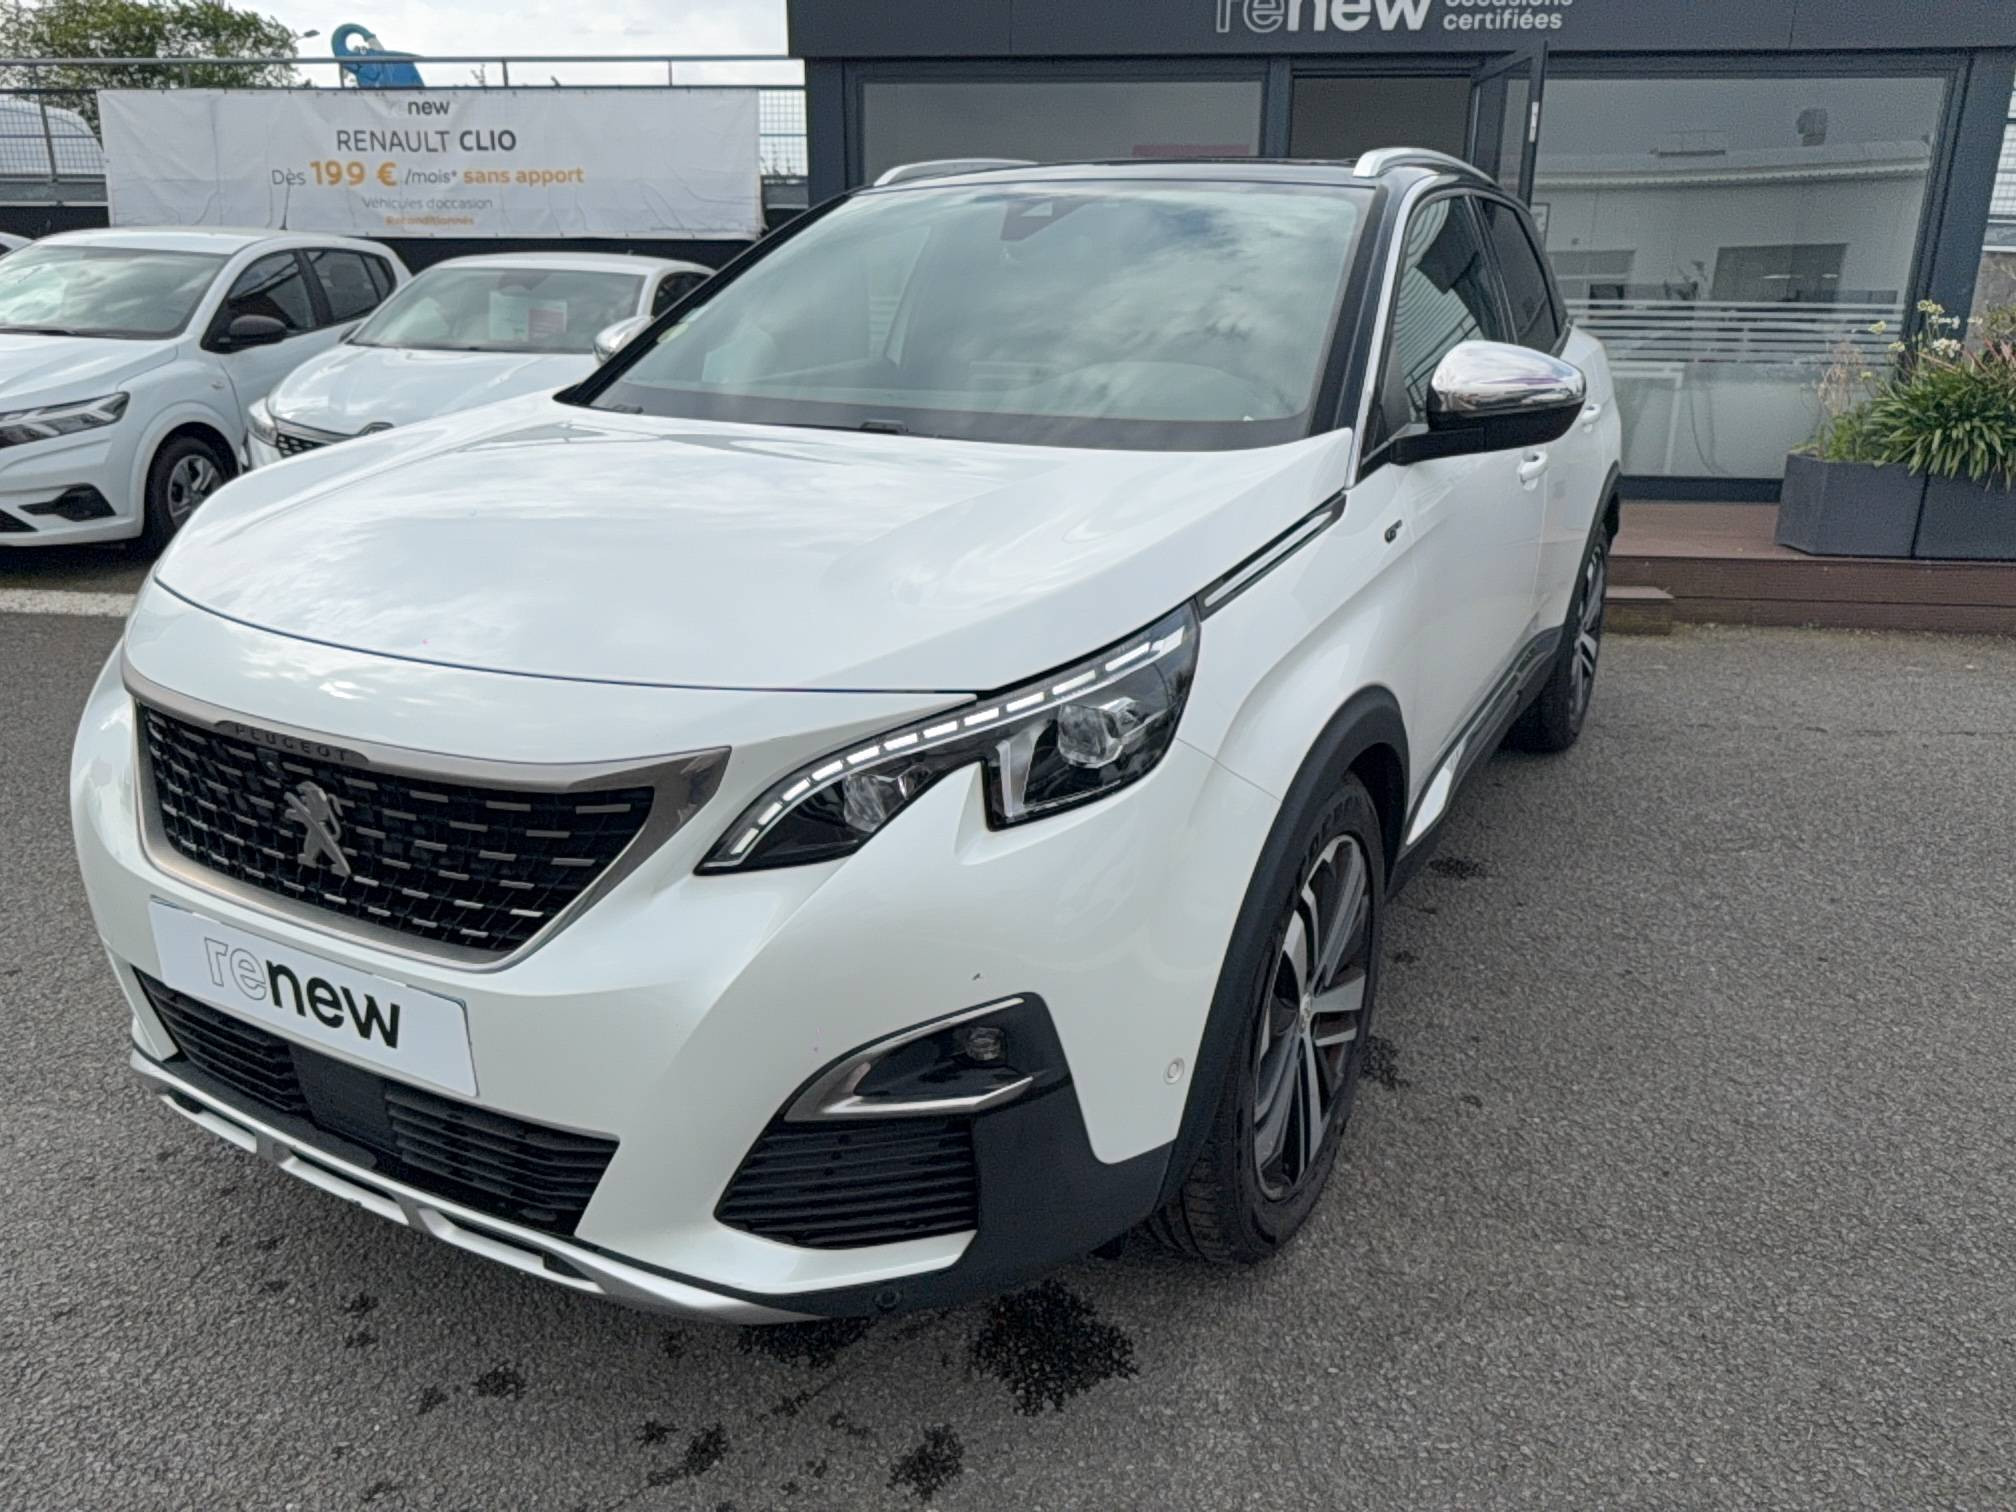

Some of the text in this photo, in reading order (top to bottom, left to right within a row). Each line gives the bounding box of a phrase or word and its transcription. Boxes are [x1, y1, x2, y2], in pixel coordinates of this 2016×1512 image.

[1215, 0, 1430, 33] renew
[1442, 8, 1563, 31] certifiées
[335, 128, 517, 153] RENAULT CLIO
[271, 167, 306, 186] Dès
[309, 160, 366, 187] 199
[377, 161, 398, 187] €
[463, 169, 511, 185] sans
[515, 167, 585, 188] apport
[235, 724, 346, 762] PEUGEOT
[204, 937, 400, 1049] renew
